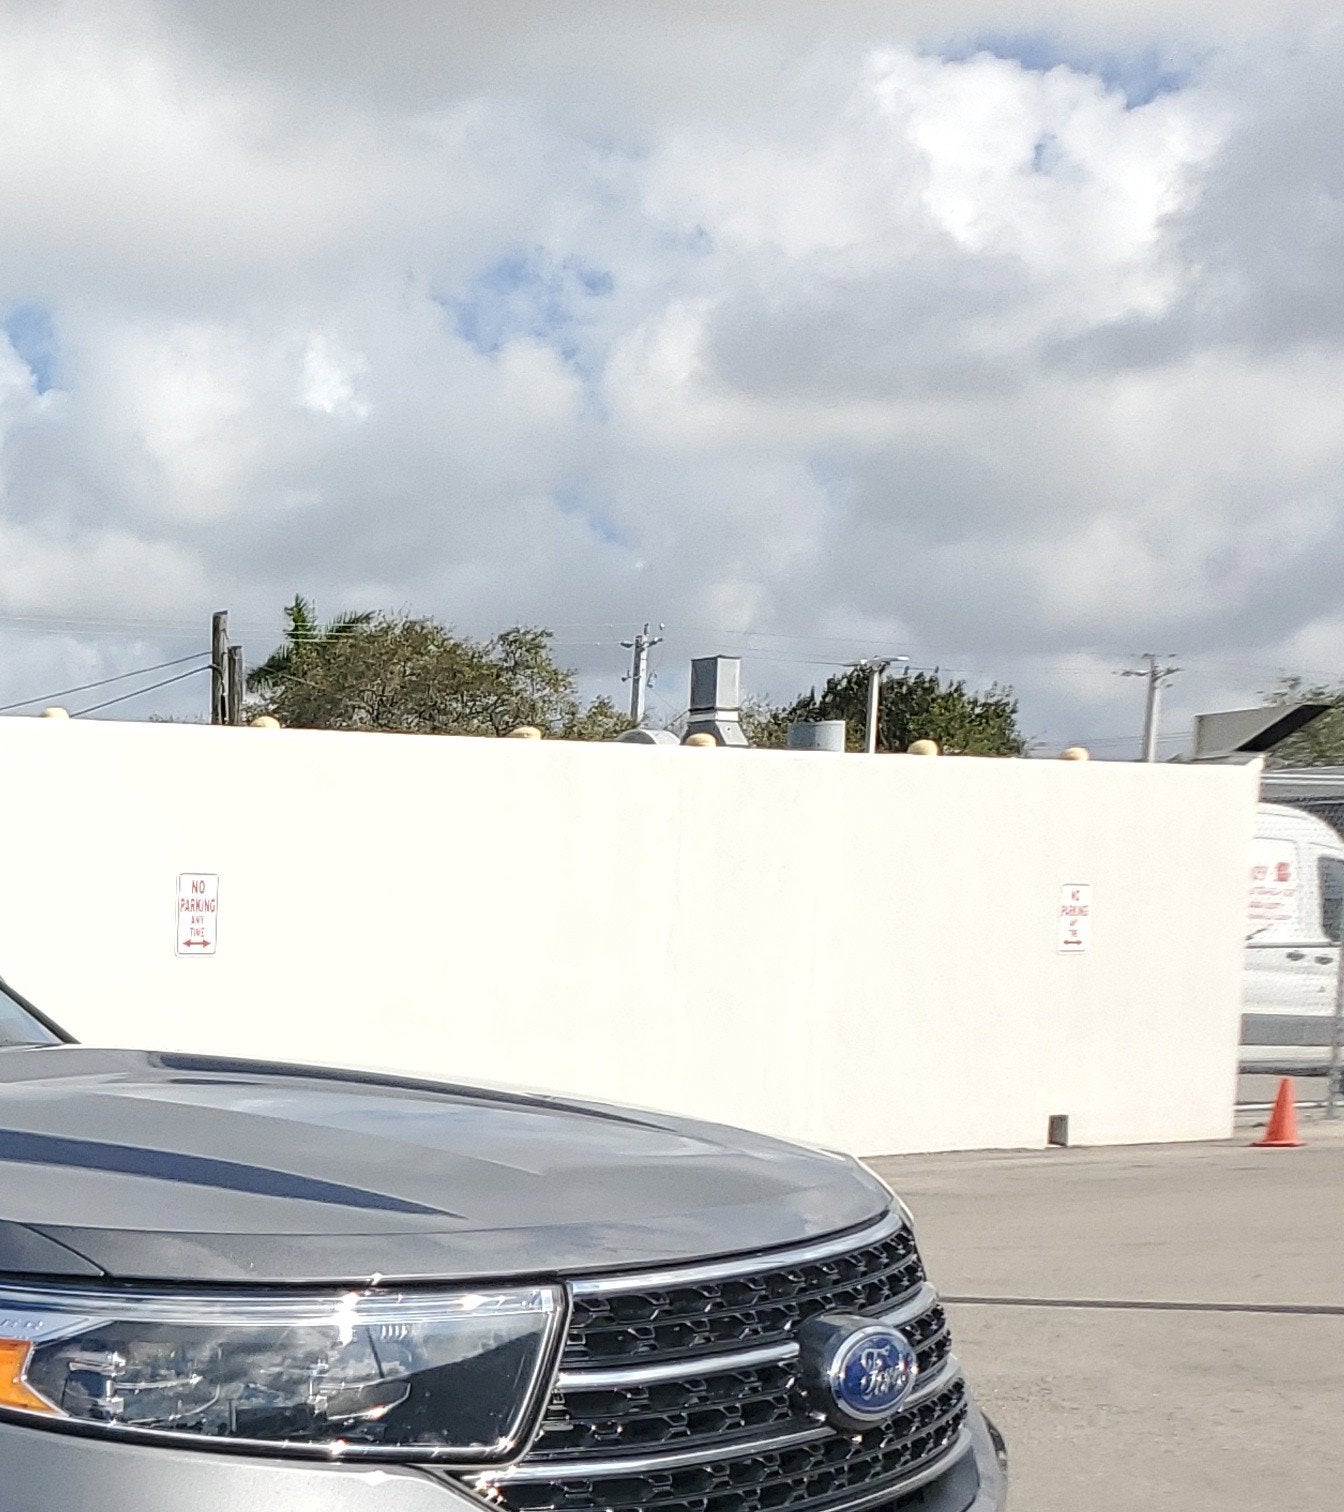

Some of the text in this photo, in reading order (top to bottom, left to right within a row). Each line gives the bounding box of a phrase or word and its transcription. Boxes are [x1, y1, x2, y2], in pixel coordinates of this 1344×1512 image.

[192, 880, 206, 894] NO
[180, 899, 215, 912] PARKING
[861, 1346, 910, 1401] Ford
